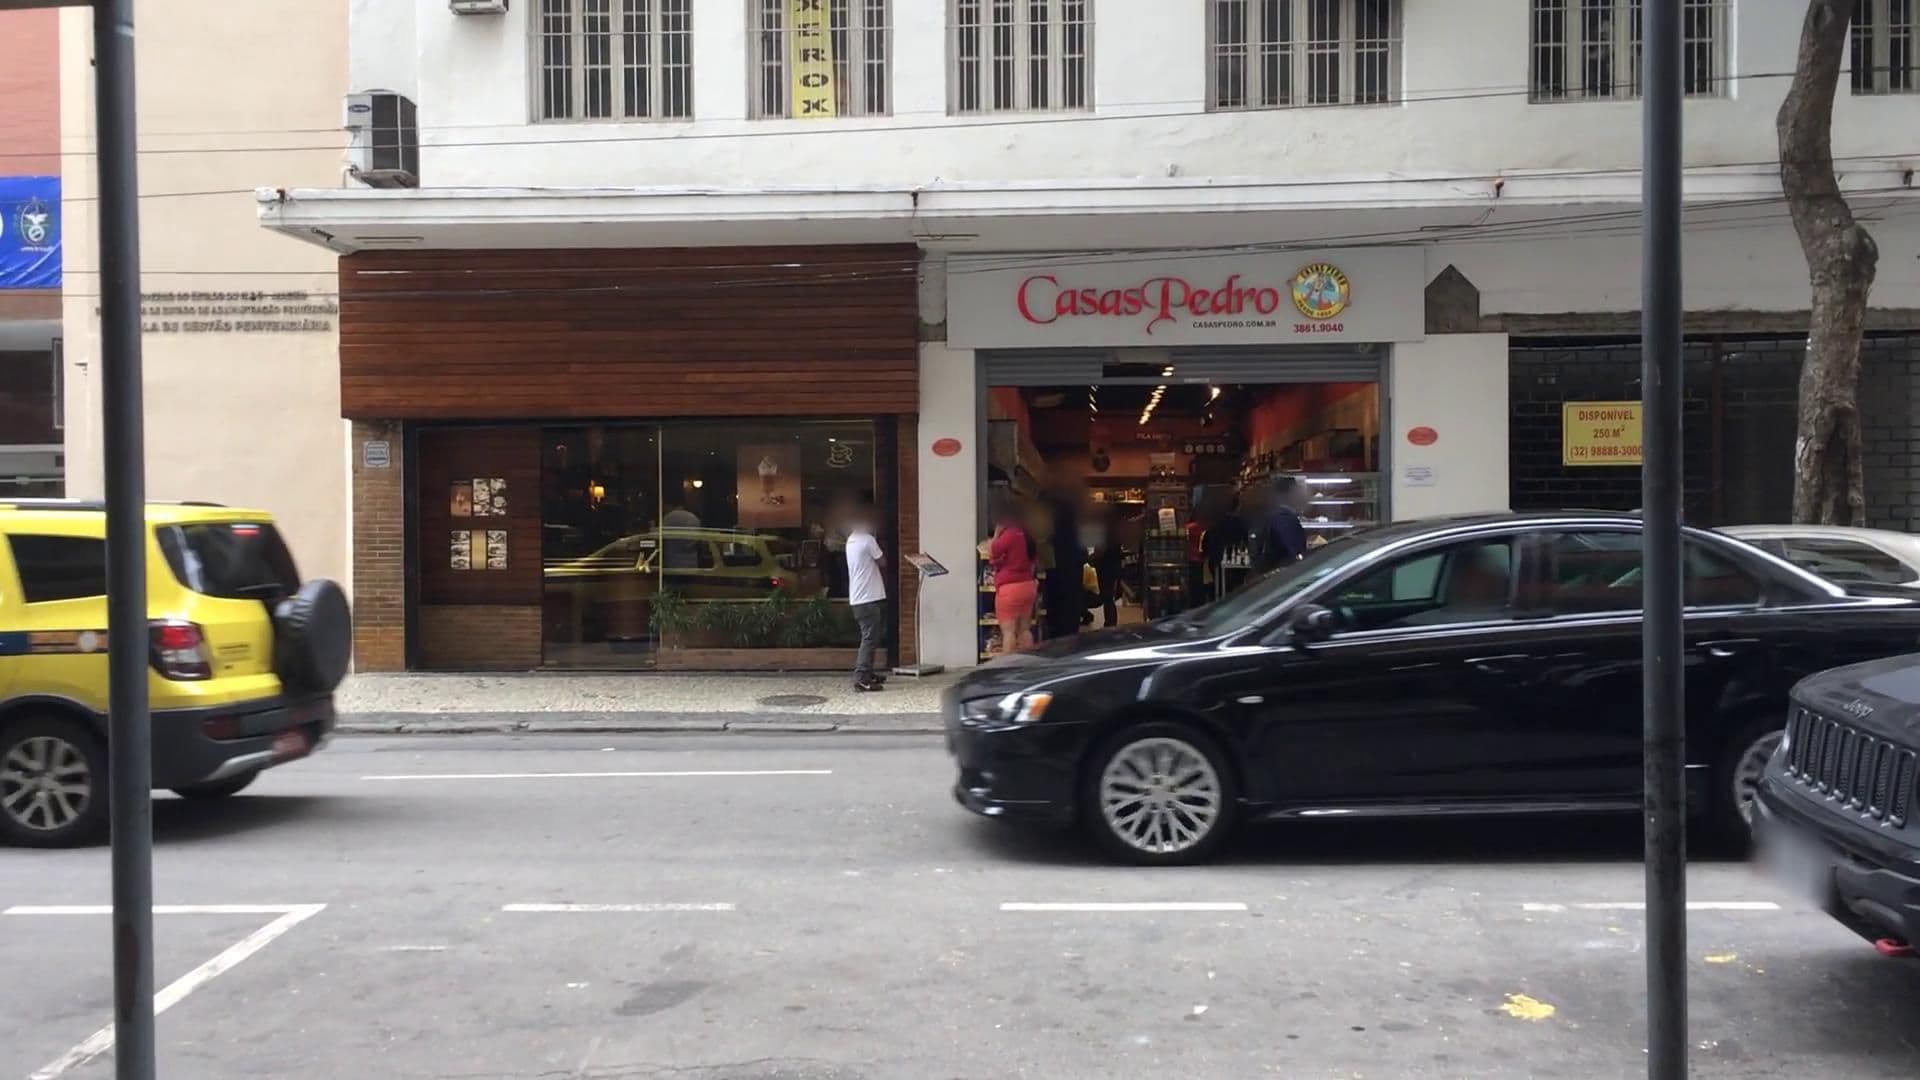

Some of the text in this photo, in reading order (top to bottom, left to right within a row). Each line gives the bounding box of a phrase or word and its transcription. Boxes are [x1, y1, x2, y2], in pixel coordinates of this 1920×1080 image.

[797, 0, 829, 113] XEROX
[1017, 274, 1279, 335] Casas Pedro
[183, 319, 232, 332] GESTÃO
[1293, 323, 1344, 333] 3861.9040
[1578, 410, 1635, 420] DISPONÍVEL
[1593, 428, 1610, 439] 250
[1570, 446, 1588, 459] (32)
[1843, 699, 1874, 719] Jeep
